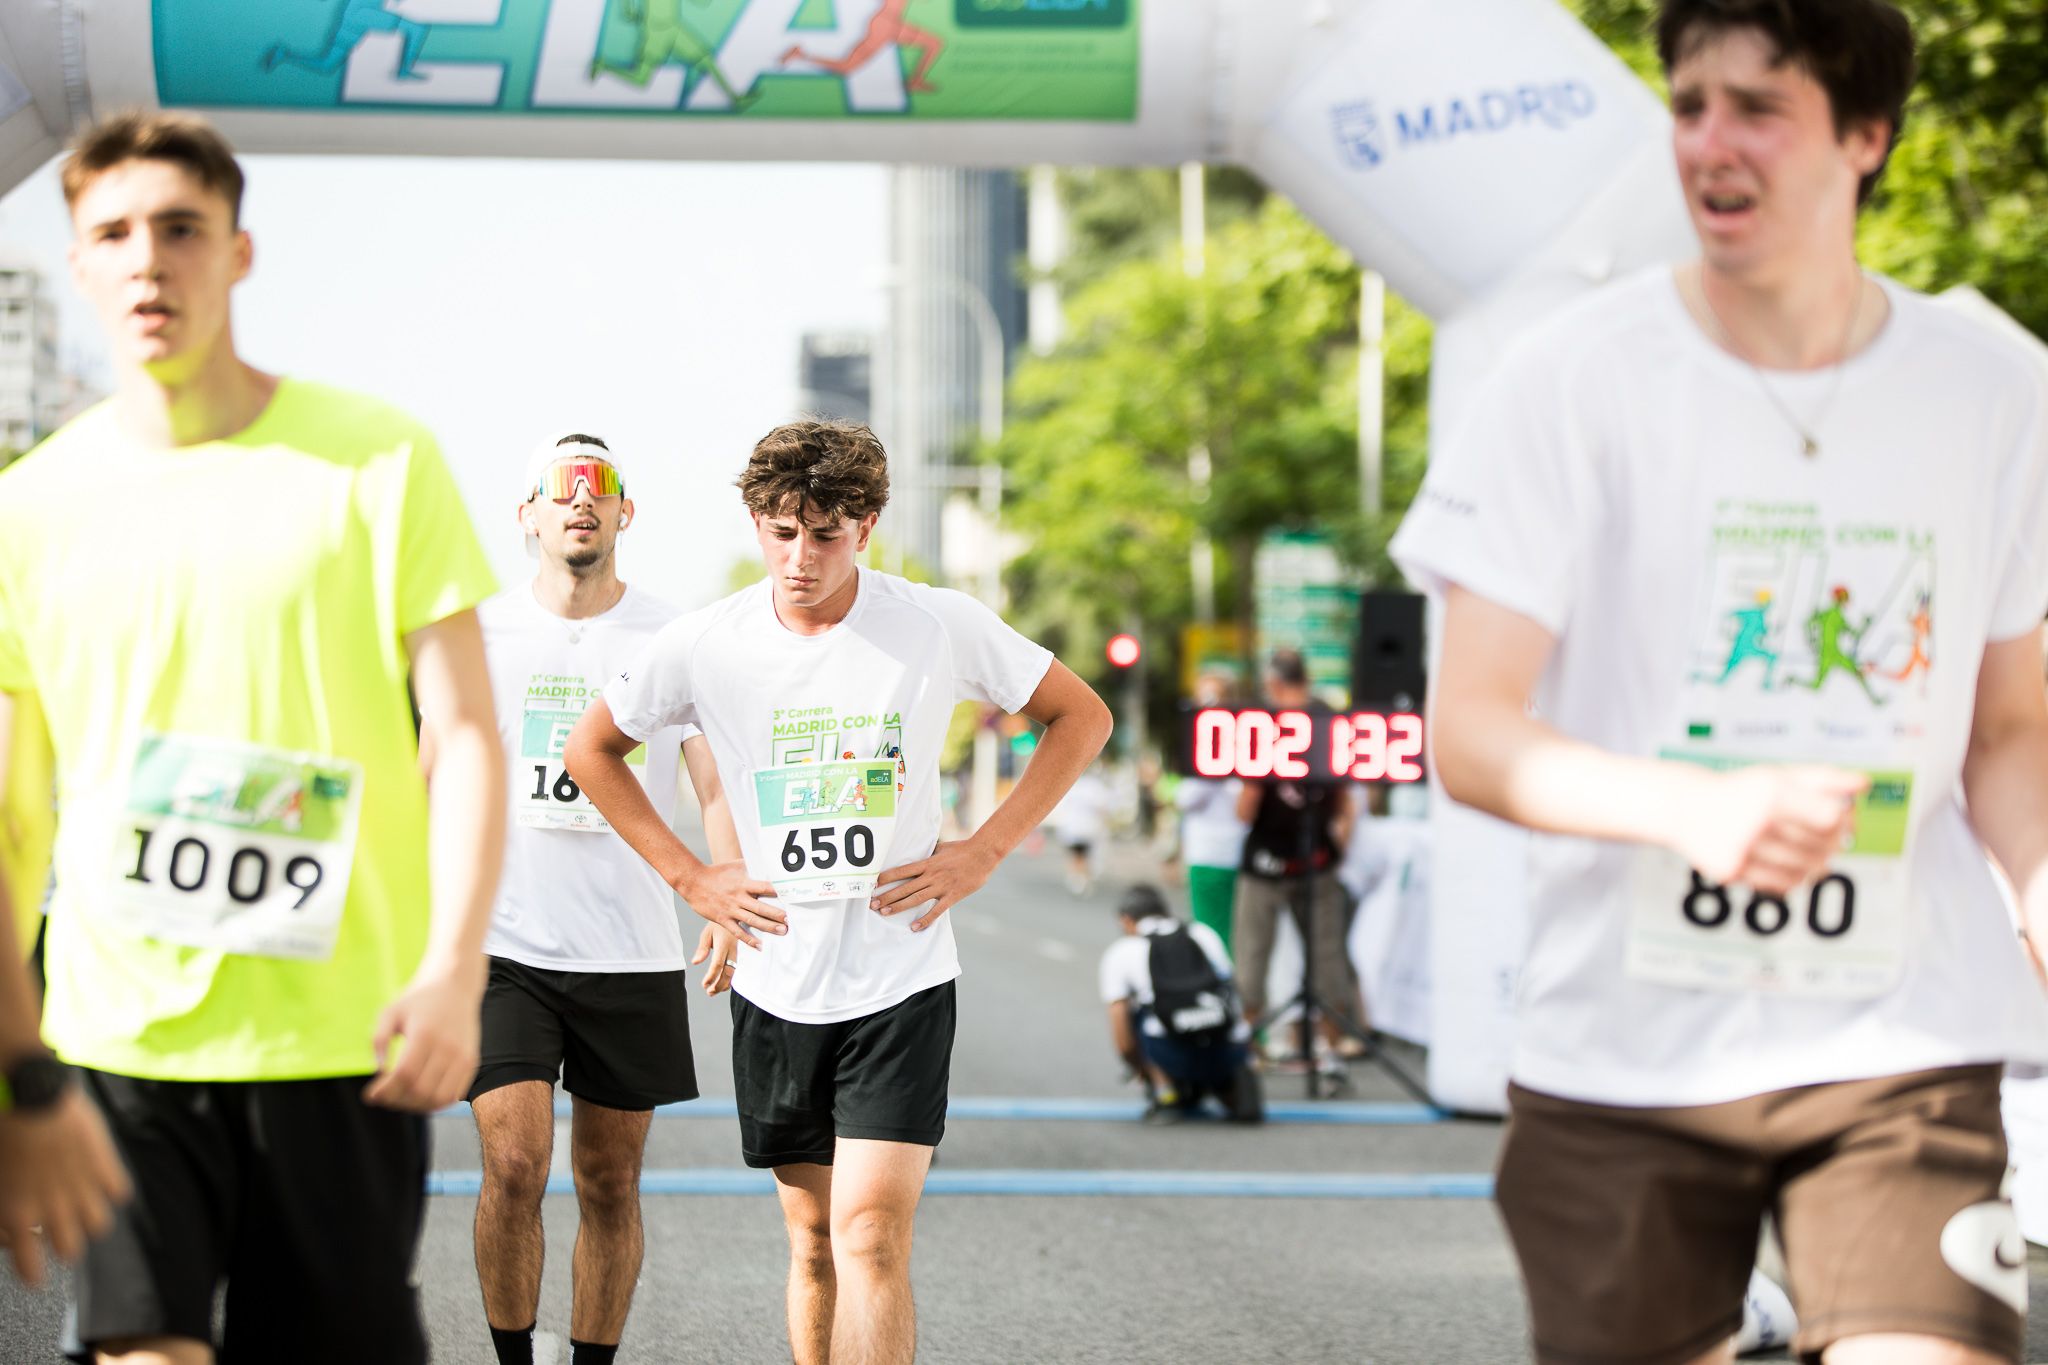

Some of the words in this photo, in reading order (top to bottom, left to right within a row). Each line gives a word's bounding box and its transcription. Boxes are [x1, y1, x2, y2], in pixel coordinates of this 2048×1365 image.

[528, 686, 587, 697] MADRID
[773, 719, 837, 736] MADRID
[842, 715, 879, 729] CON
[883, 712, 901, 725] LA
[788, 706, 833, 719] Carrera
[785, 768, 820, 779] MADRID
[823, 767, 845, 777] CON
[782, 776, 866, 817] ELA
[781, 824, 874, 873] 650
[126, 828, 323, 910] 1009
